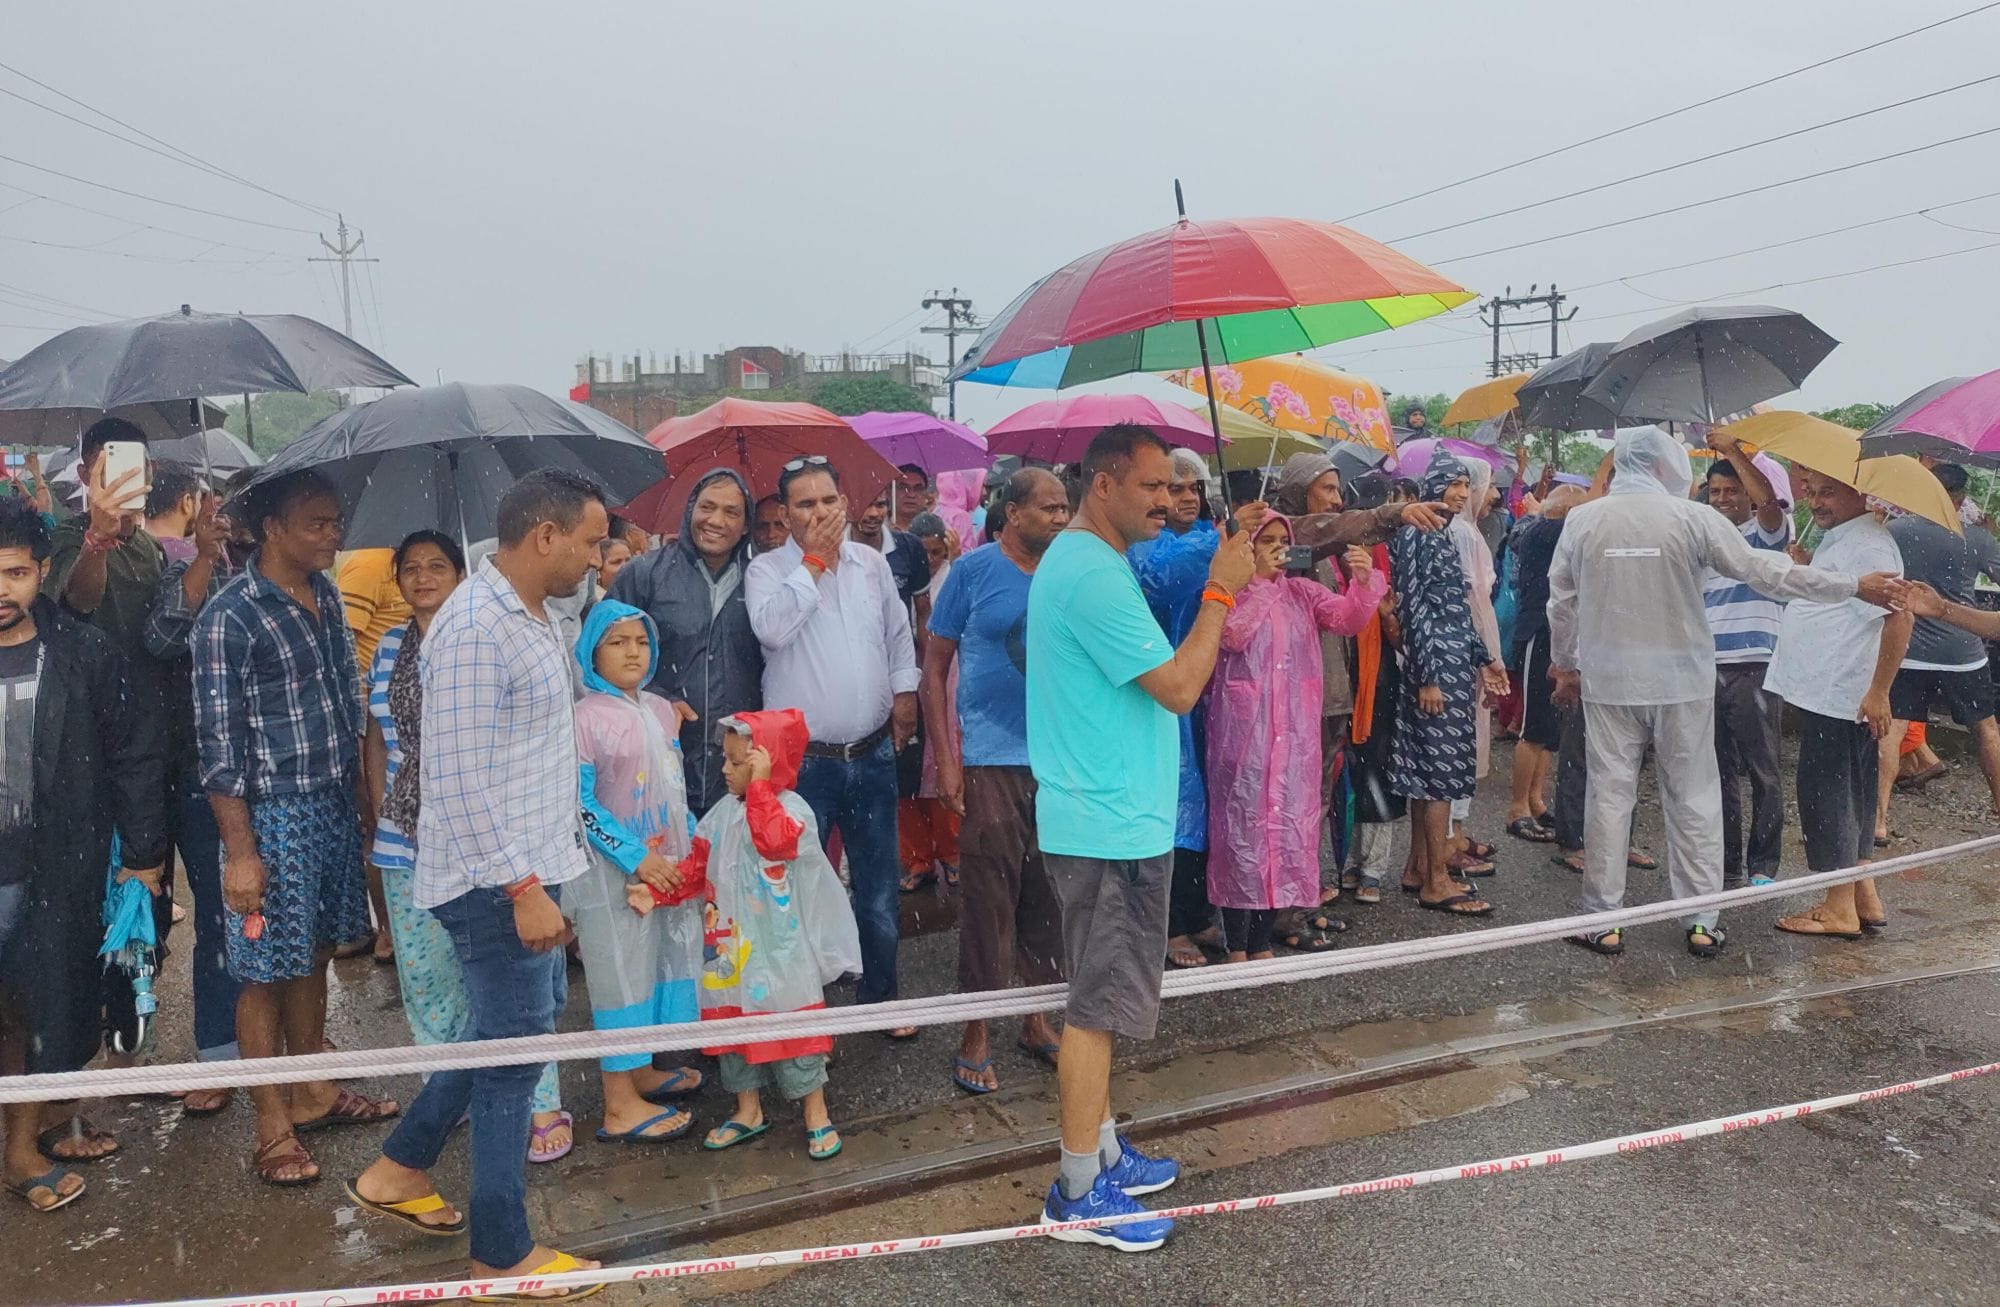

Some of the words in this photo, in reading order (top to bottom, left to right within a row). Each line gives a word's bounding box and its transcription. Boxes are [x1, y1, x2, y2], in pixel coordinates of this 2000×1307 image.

[1616, 1132, 1683, 1152] CAUTION
[1722, 1116, 1760, 1131] MEN
[1766, 1112, 1784, 1123] AT
[1339, 1177, 1414, 1196] CAUTION
[1461, 1163, 1503, 1177] MEN
[1510, 1158, 1530, 1171] AT
